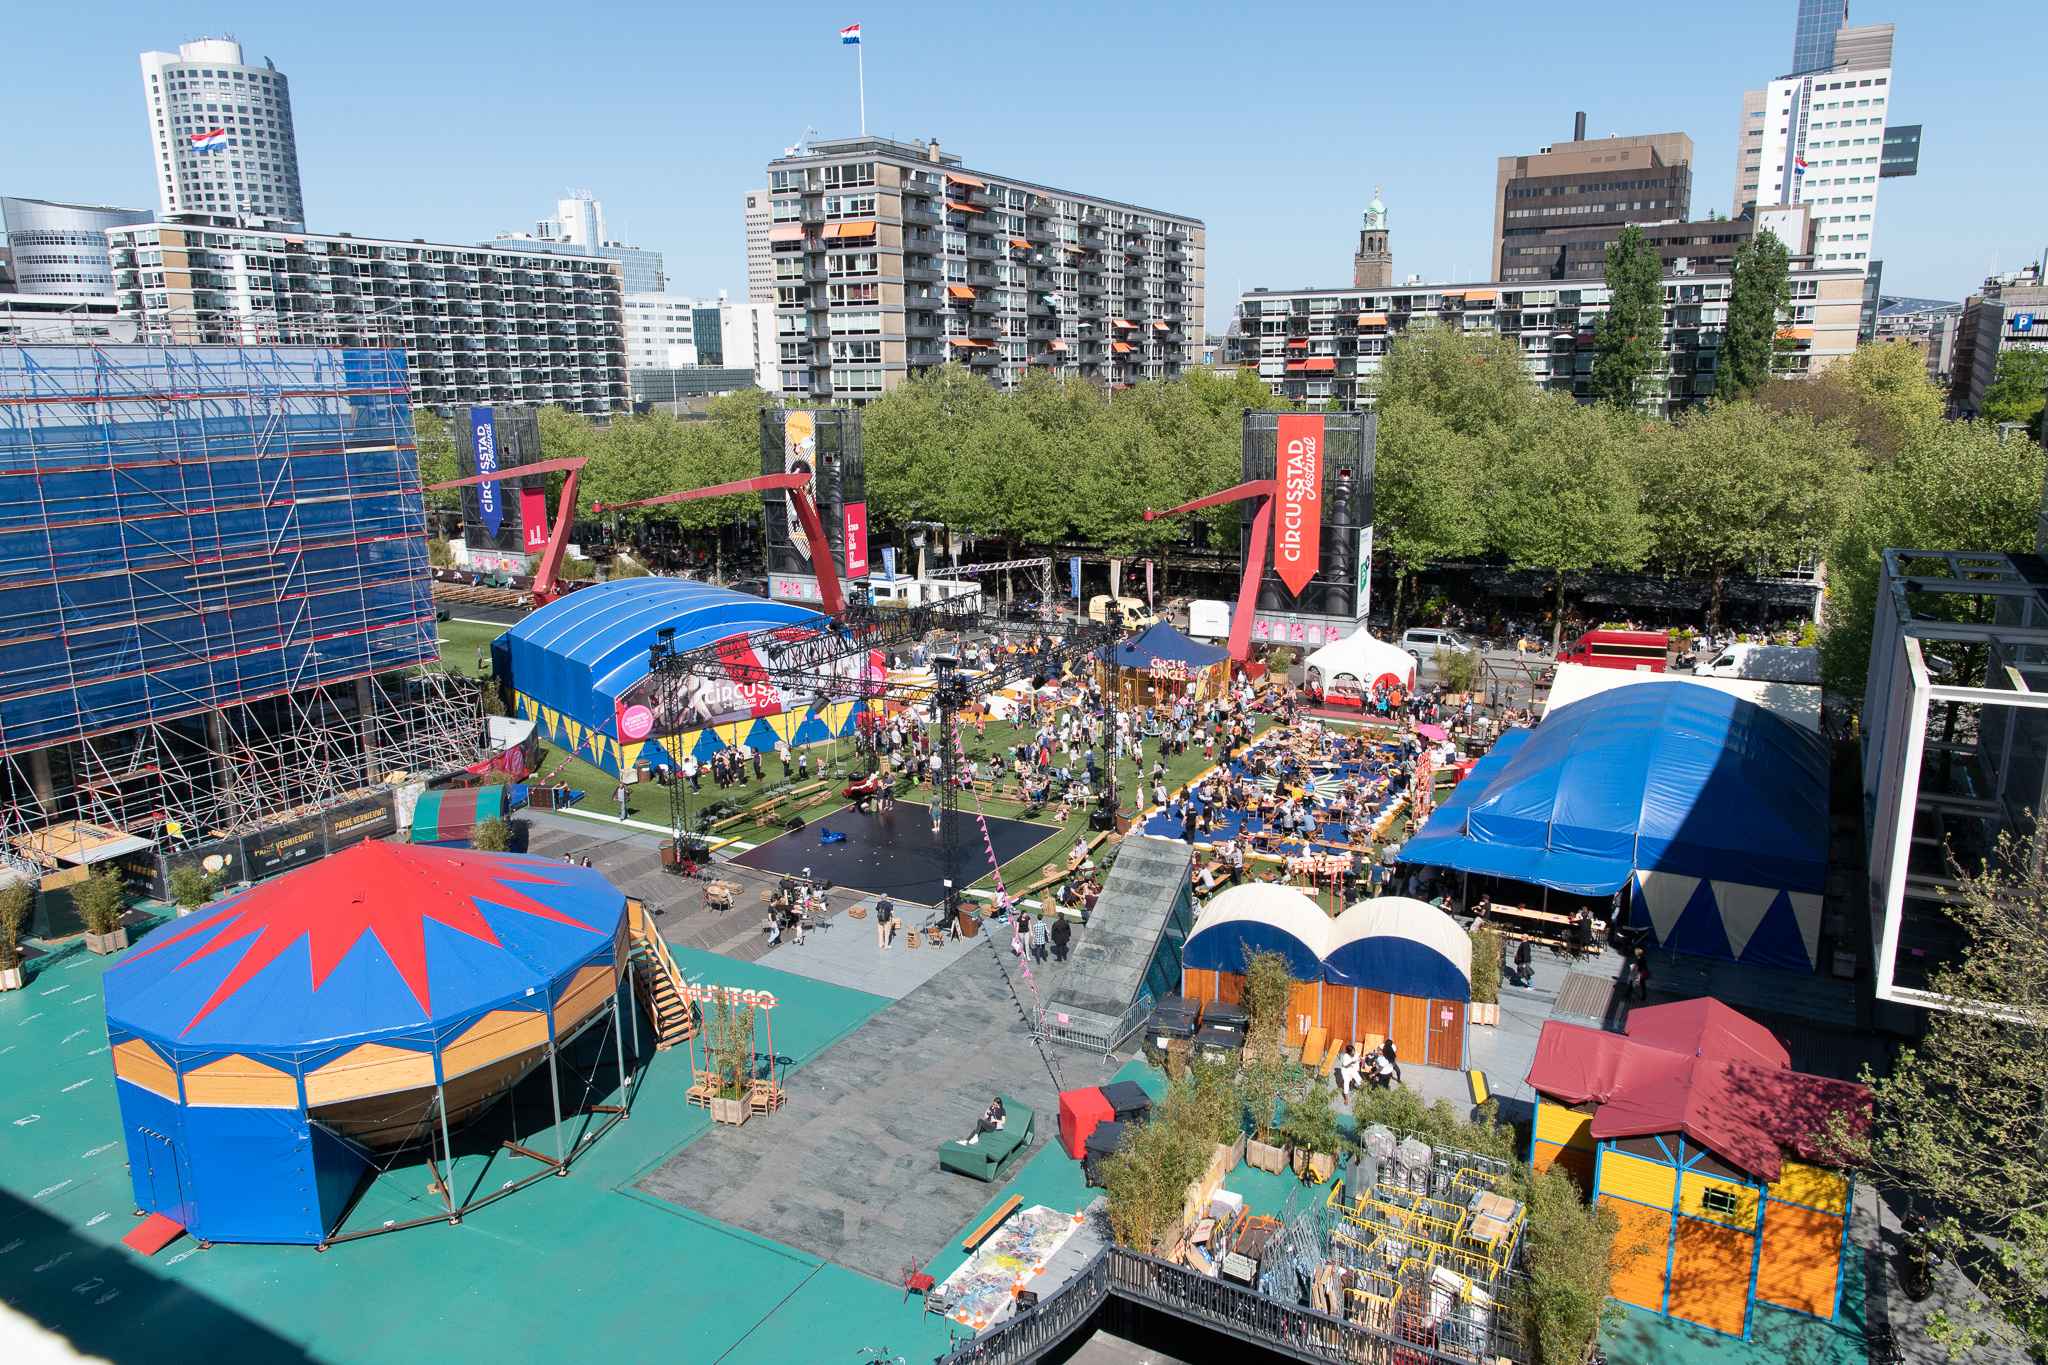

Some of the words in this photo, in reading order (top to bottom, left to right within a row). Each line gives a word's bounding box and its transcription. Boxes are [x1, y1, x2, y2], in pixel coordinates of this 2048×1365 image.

[2018, 316, 2029, 329] P
[477, 426, 493, 512] CIRCSSTAD
[1300, 436, 1316, 500] Festival
[1280, 439, 1304, 562] CIRCUSSTAD
[1149, 667, 1186, 681] JUNGLE
[1151, 656, 1188, 670] CIRCUS
